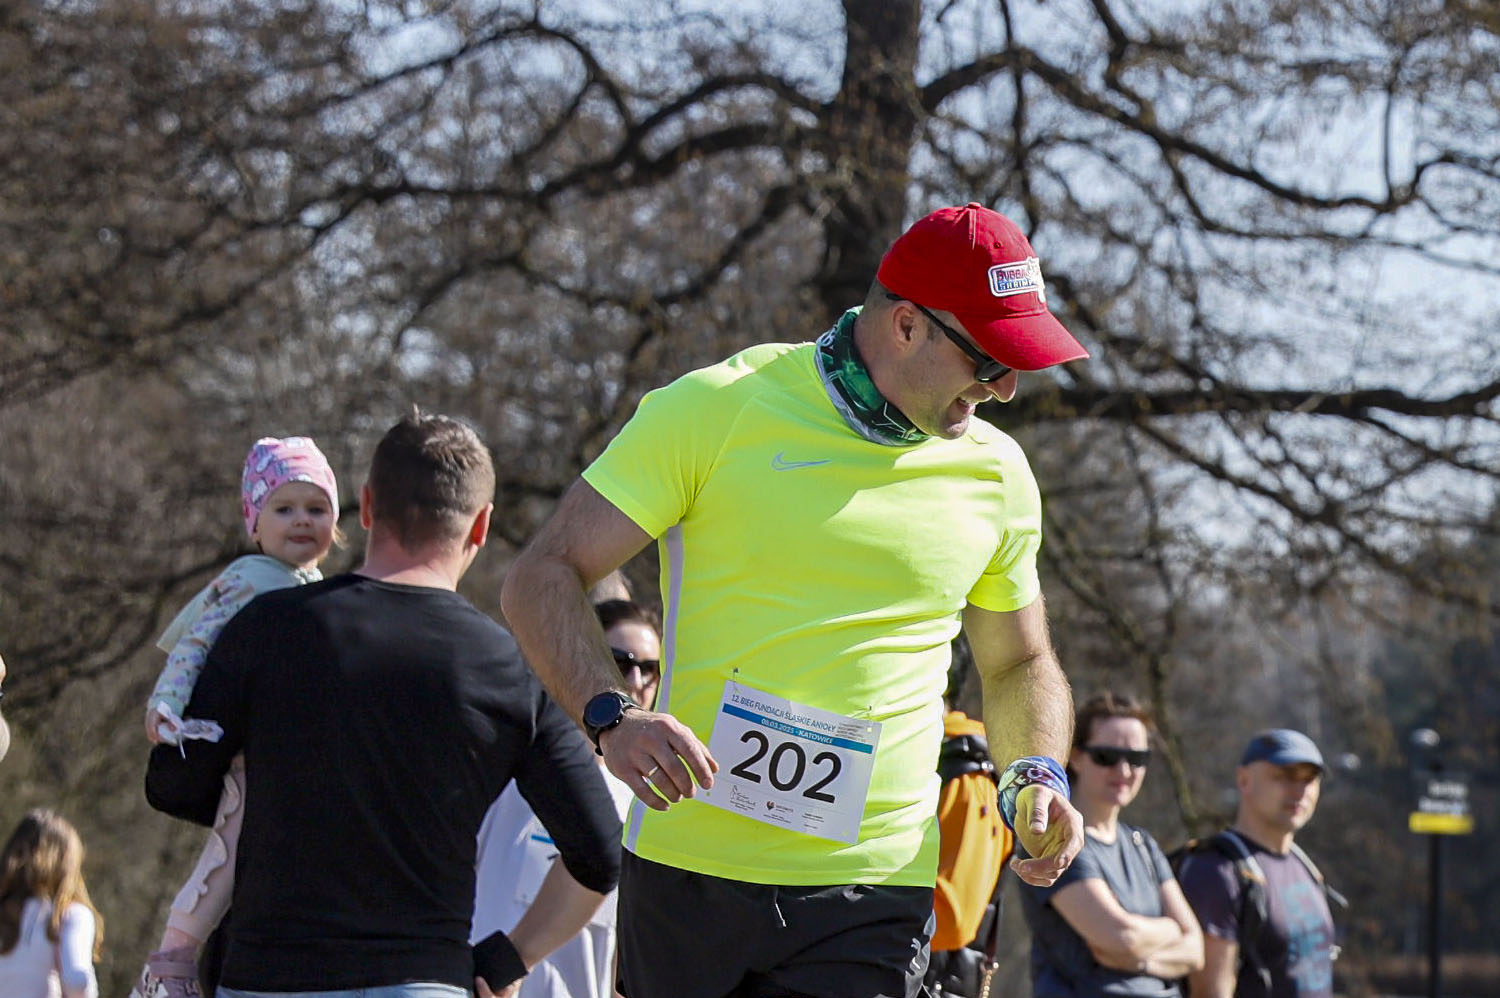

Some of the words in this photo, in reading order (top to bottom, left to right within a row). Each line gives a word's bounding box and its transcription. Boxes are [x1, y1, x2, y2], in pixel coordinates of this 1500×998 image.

[740, 696, 754, 708] BIEG
[755, 702, 784, 717] FUNDACJI
[811, 719, 837, 733] ANIOŁY
[799, 729, 833, 745] KATOWICE
[730, 730, 842, 804] 202
